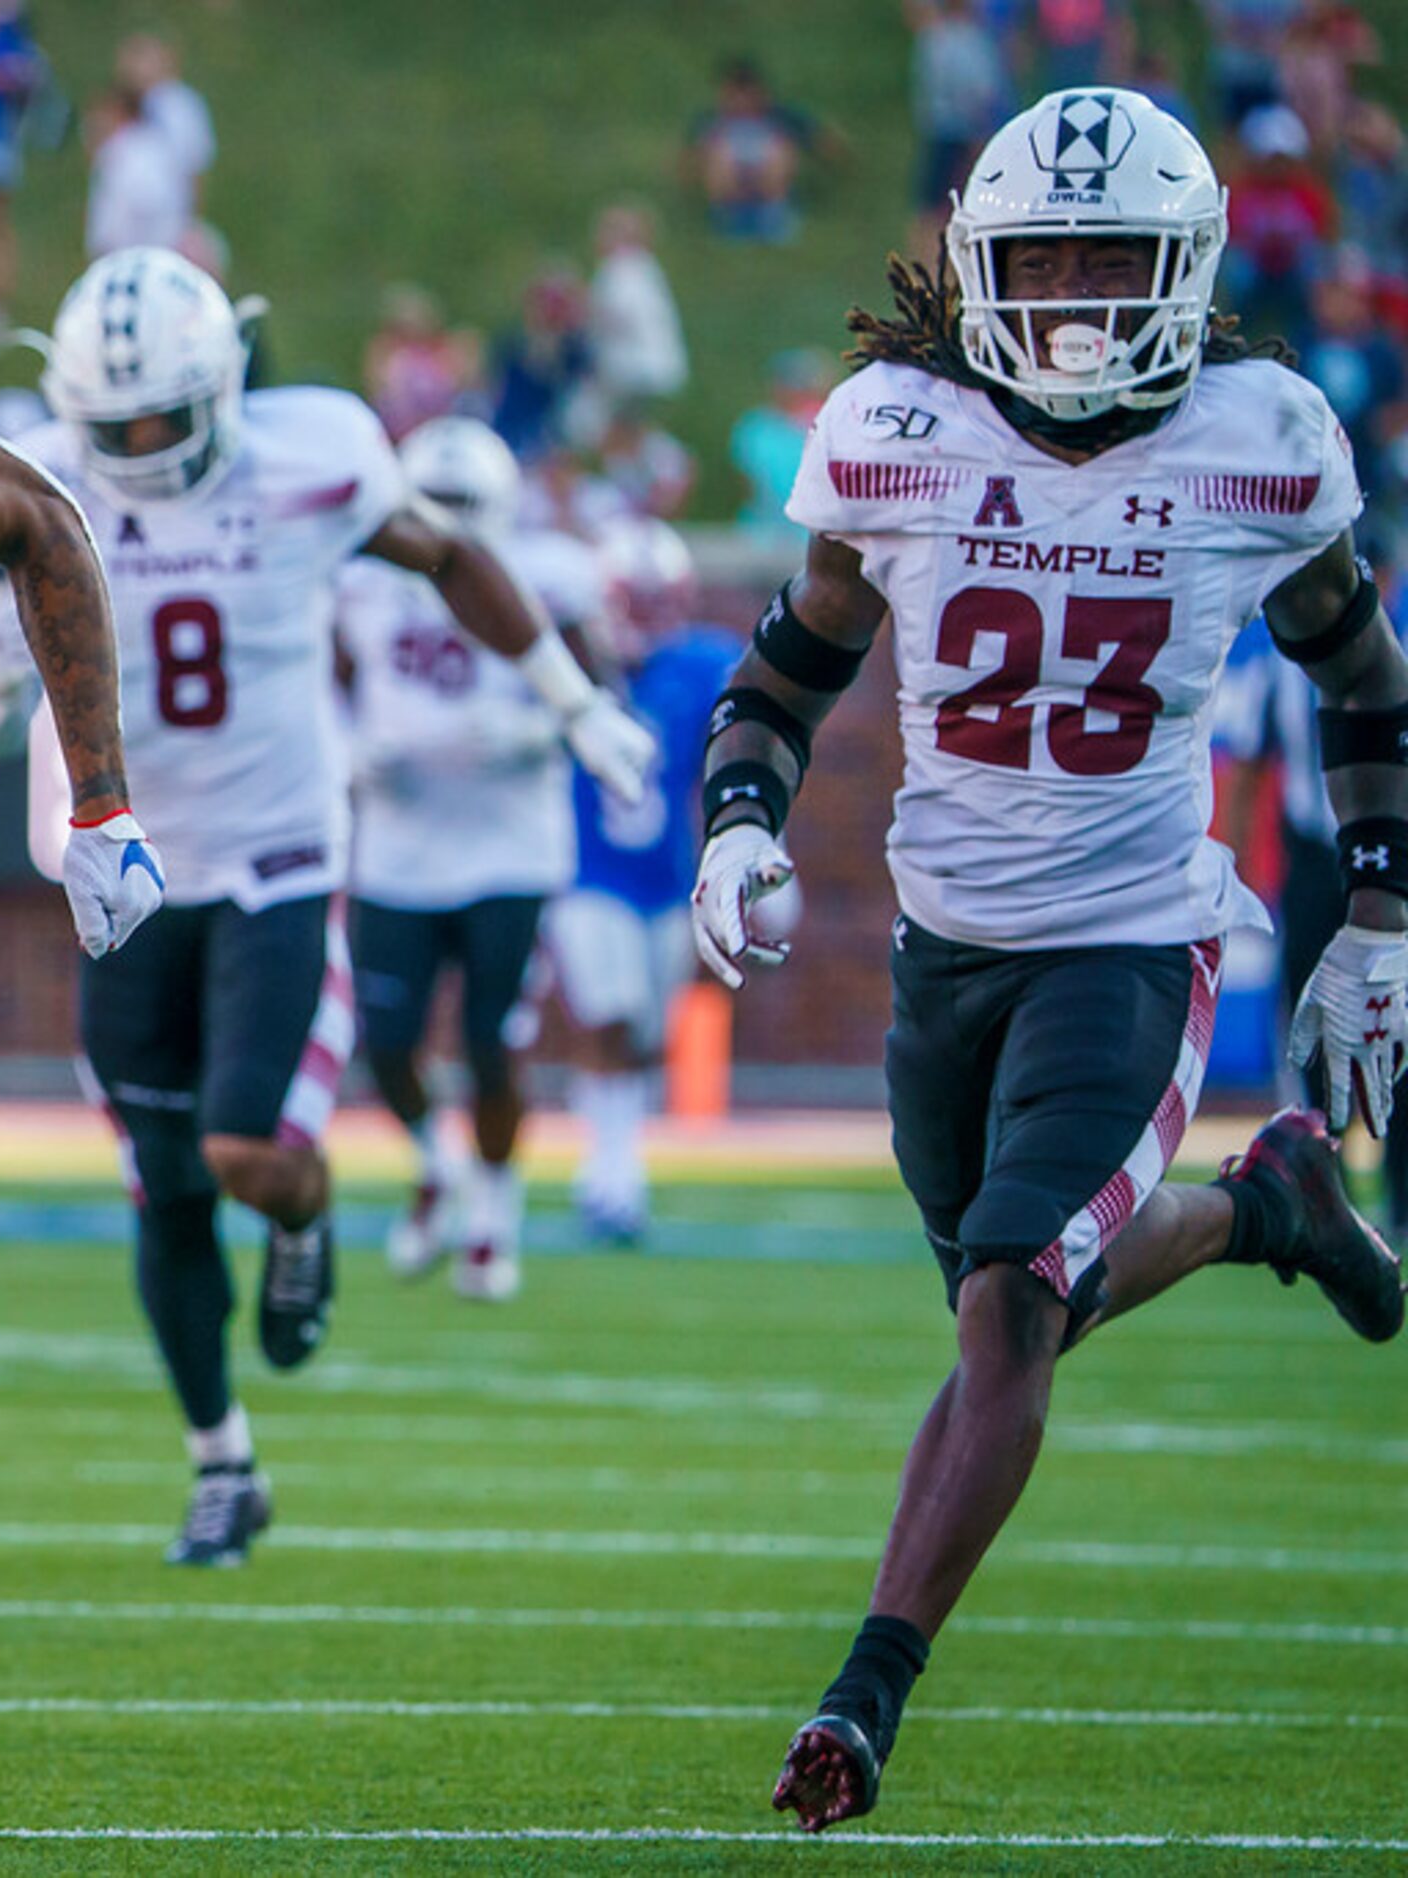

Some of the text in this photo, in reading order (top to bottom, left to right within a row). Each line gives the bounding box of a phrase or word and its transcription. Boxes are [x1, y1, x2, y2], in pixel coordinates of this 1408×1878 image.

[1046, 191, 1103, 205] OWLS
[863, 404, 938, 442] 150
[957, 534, 1166, 578] TEMPLE
[153, 596, 229, 728] 8
[934, 585, 1174, 777] 23
